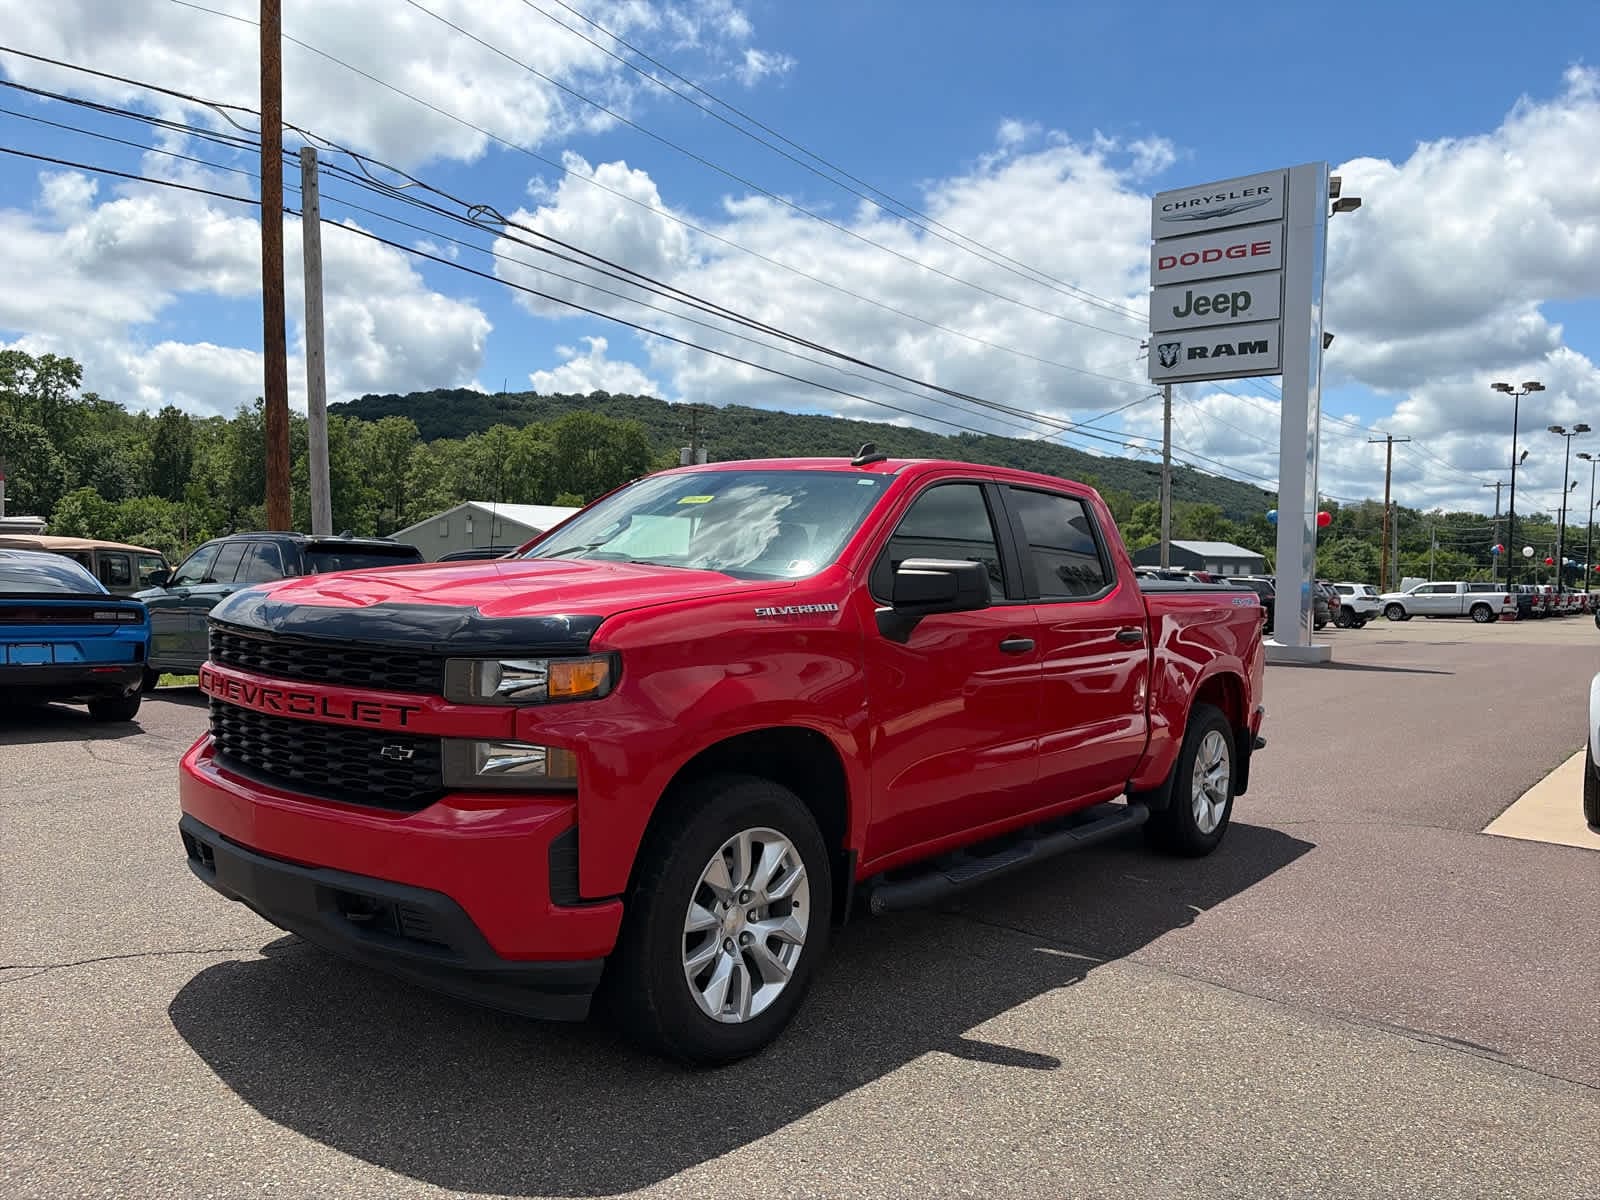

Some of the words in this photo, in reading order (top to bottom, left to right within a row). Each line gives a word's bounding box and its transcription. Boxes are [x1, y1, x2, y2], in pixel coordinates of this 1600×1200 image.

[1162, 186, 1271, 212] CHRYSLER
[1158, 240, 1272, 270] DODGE
[1172, 290, 1252, 318] Jeep
[1187, 340, 1269, 361] RAM
[754, 603, 839, 617] SILVERADO
[200, 671, 421, 726] CHEVROLET
